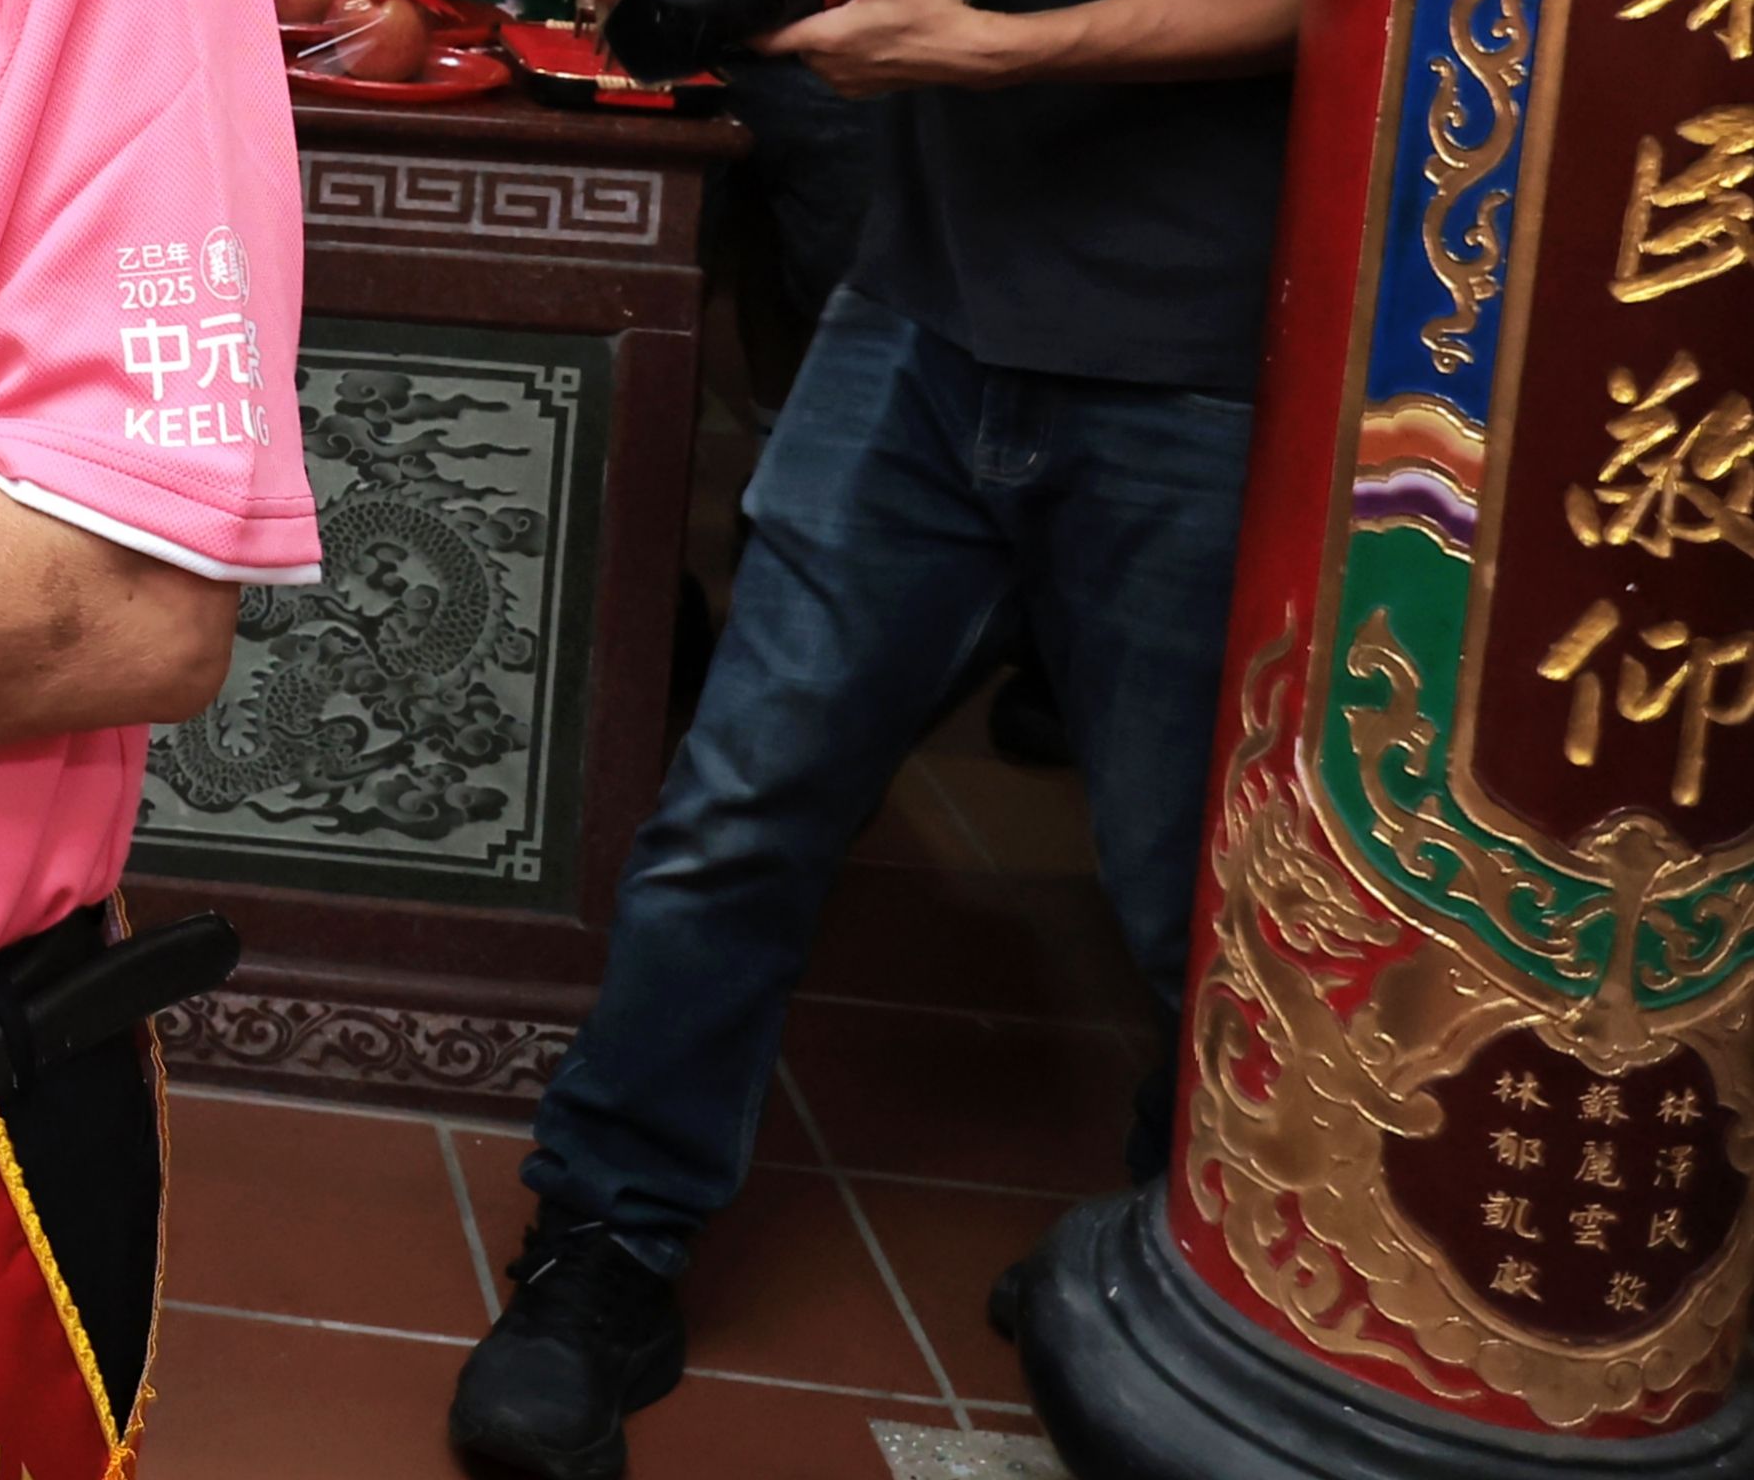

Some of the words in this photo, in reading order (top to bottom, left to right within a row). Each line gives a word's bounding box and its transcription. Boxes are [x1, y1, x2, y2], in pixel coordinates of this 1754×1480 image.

[117, 242, 192, 272] 乙巳年
[118, 276, 197, 311] 2025
